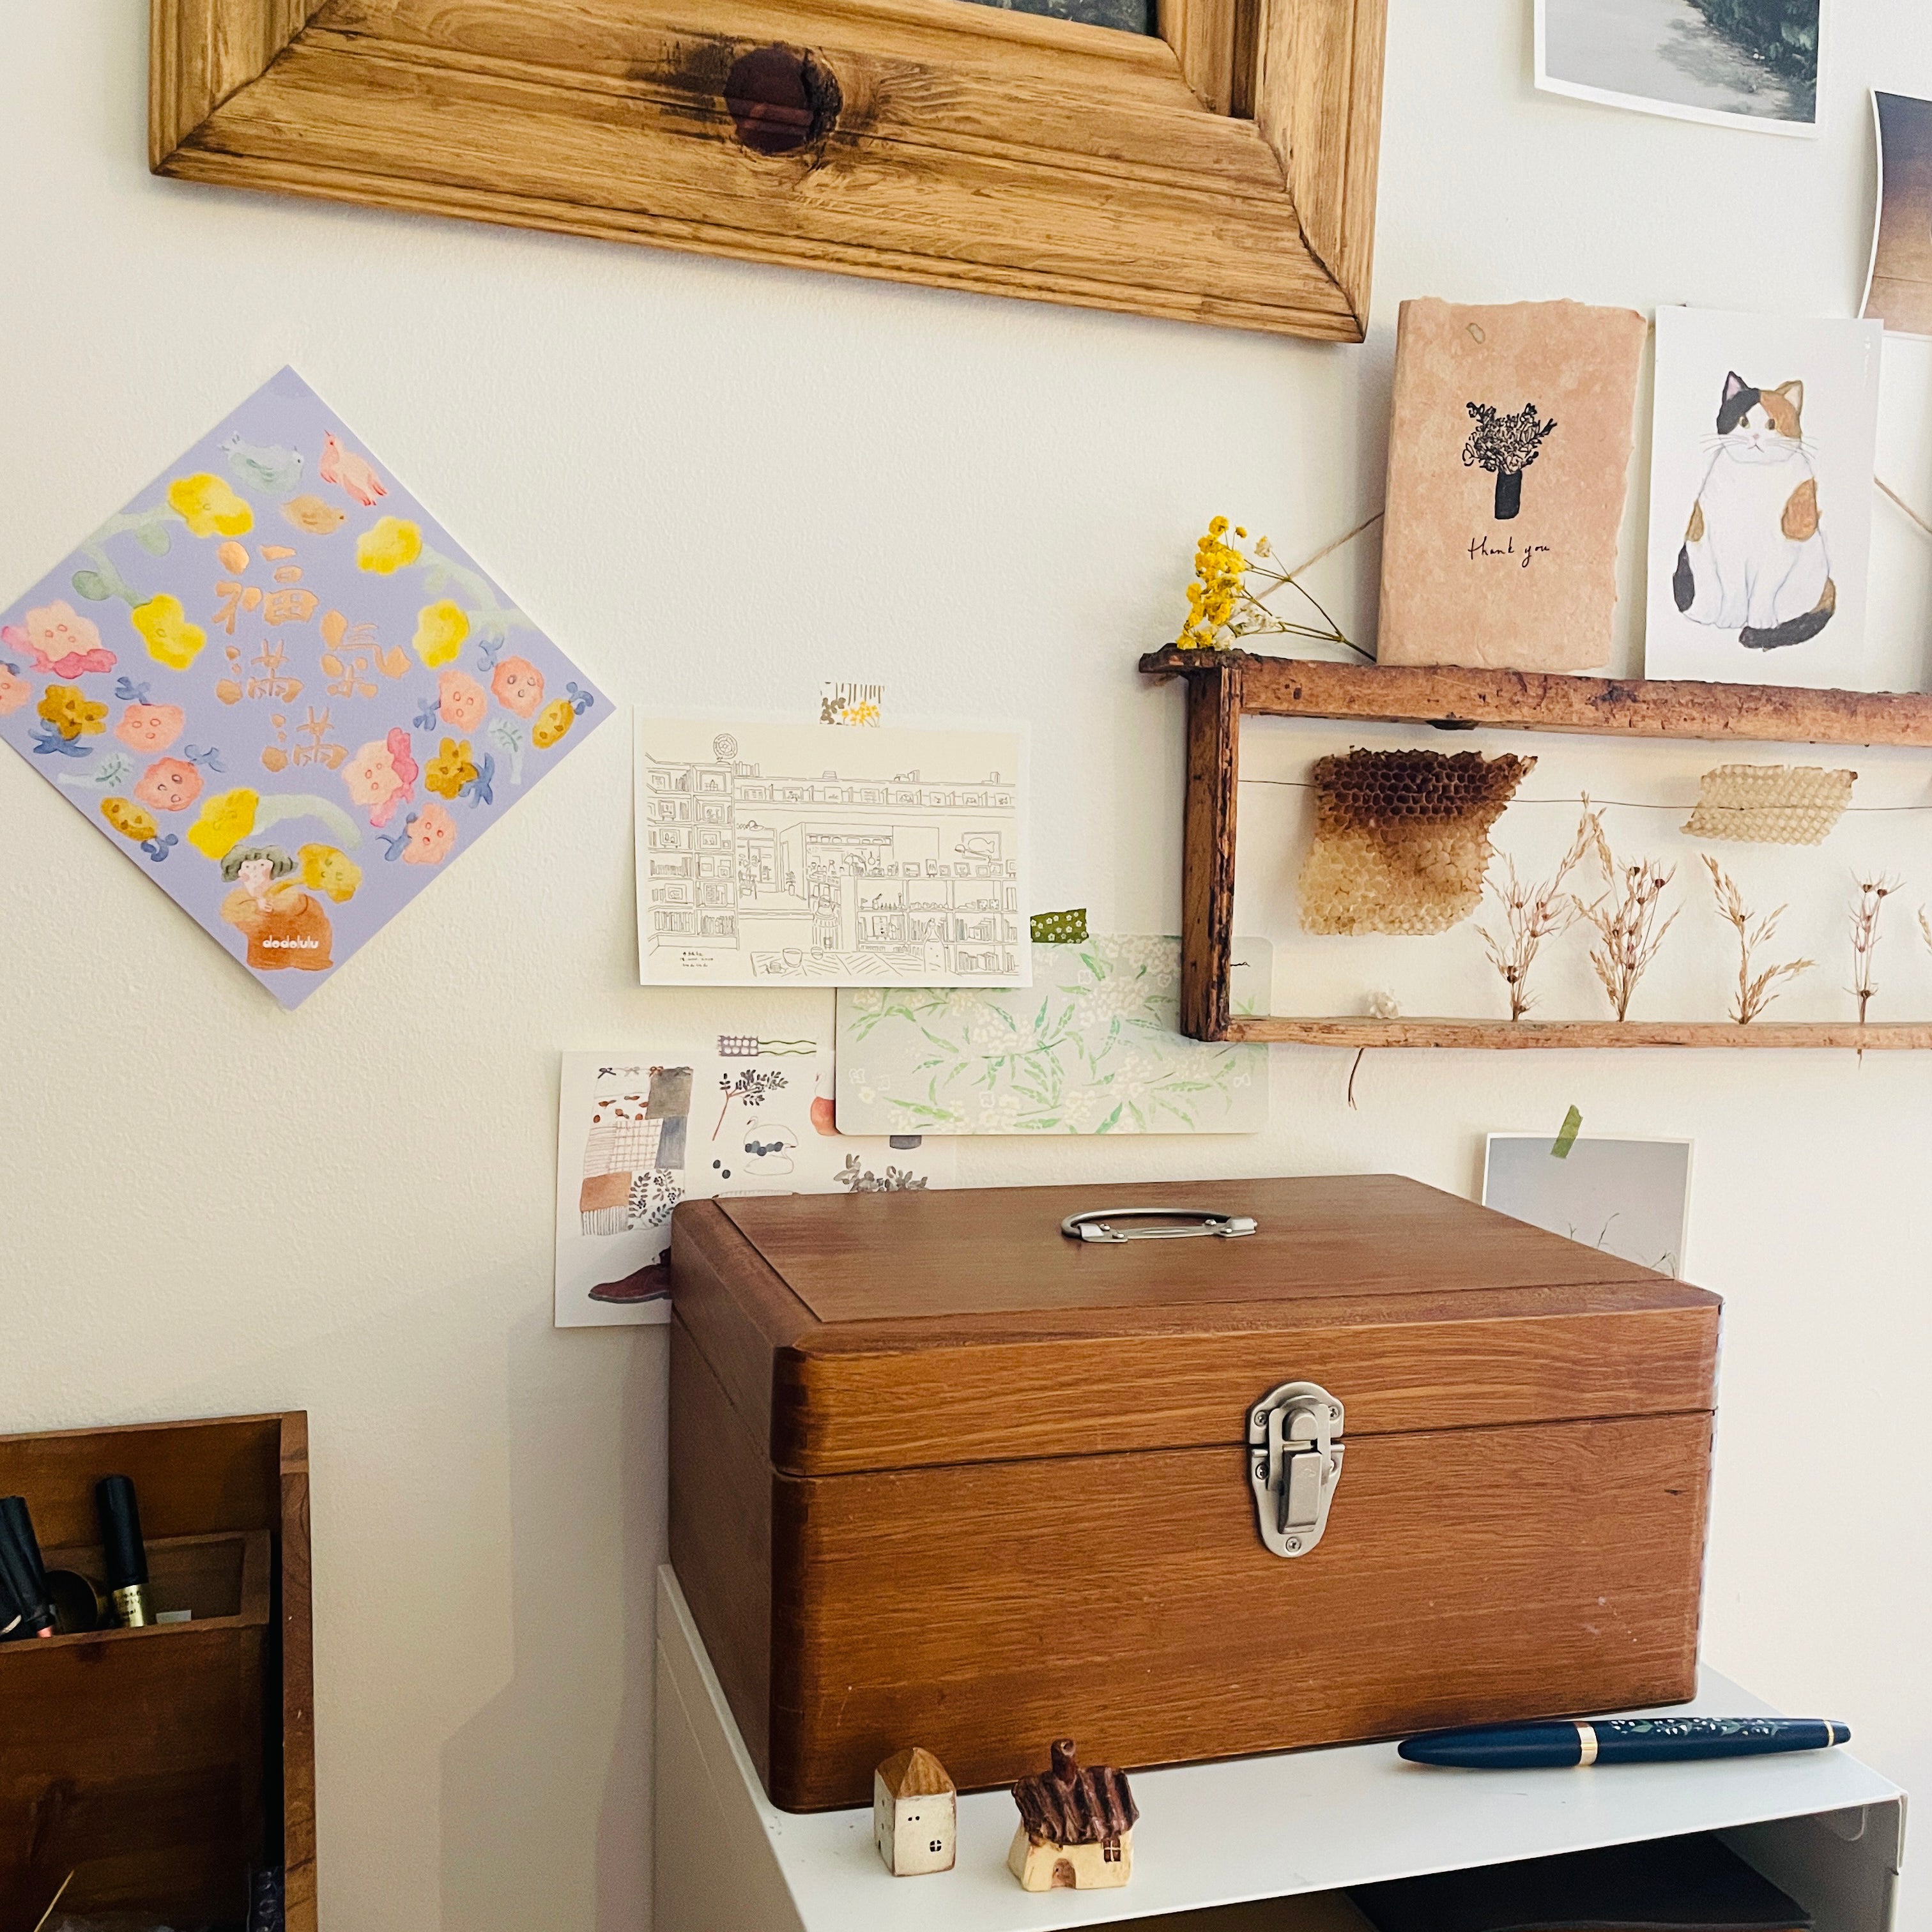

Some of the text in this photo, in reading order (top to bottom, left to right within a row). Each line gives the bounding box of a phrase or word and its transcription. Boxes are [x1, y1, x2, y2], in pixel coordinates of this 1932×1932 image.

[1468, 535, 1551, 569] thank you
[263, 935, 319, 949] dodolulu
